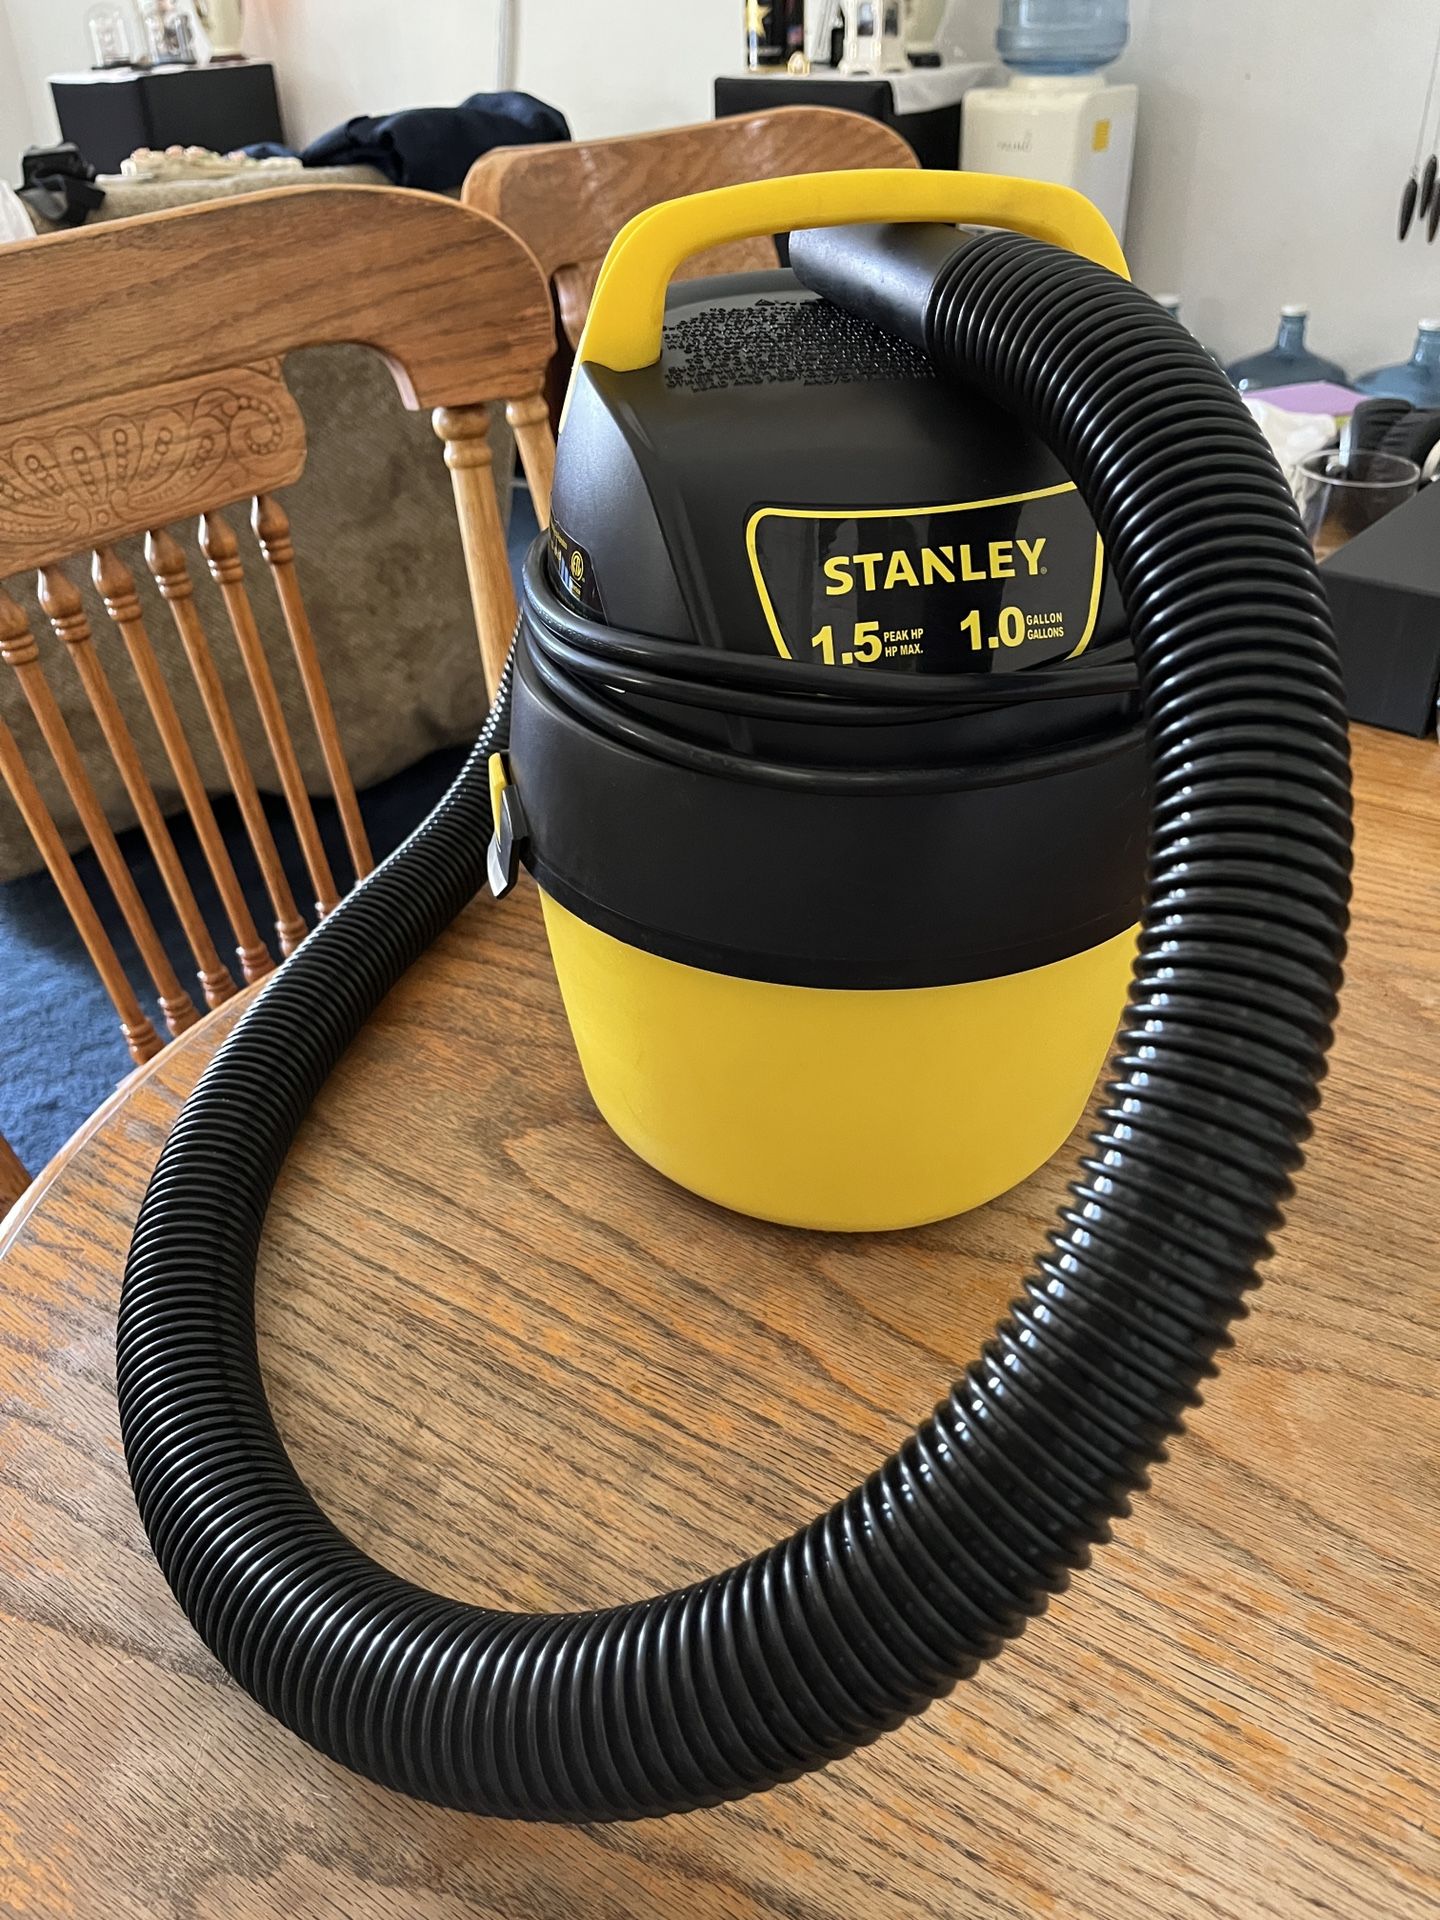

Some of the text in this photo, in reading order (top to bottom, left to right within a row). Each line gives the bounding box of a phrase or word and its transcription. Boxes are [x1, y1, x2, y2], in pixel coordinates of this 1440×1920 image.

[823, 537, 1047, 596] STANLEY
[811, 620, 925, 666] 1.5 PEAK HP
[884, 643, 924, 658] HP MAX.
[960, 606, 1063, 651] 1.0 GALLON
[1027, 626, 1065, 640] GALLONS
